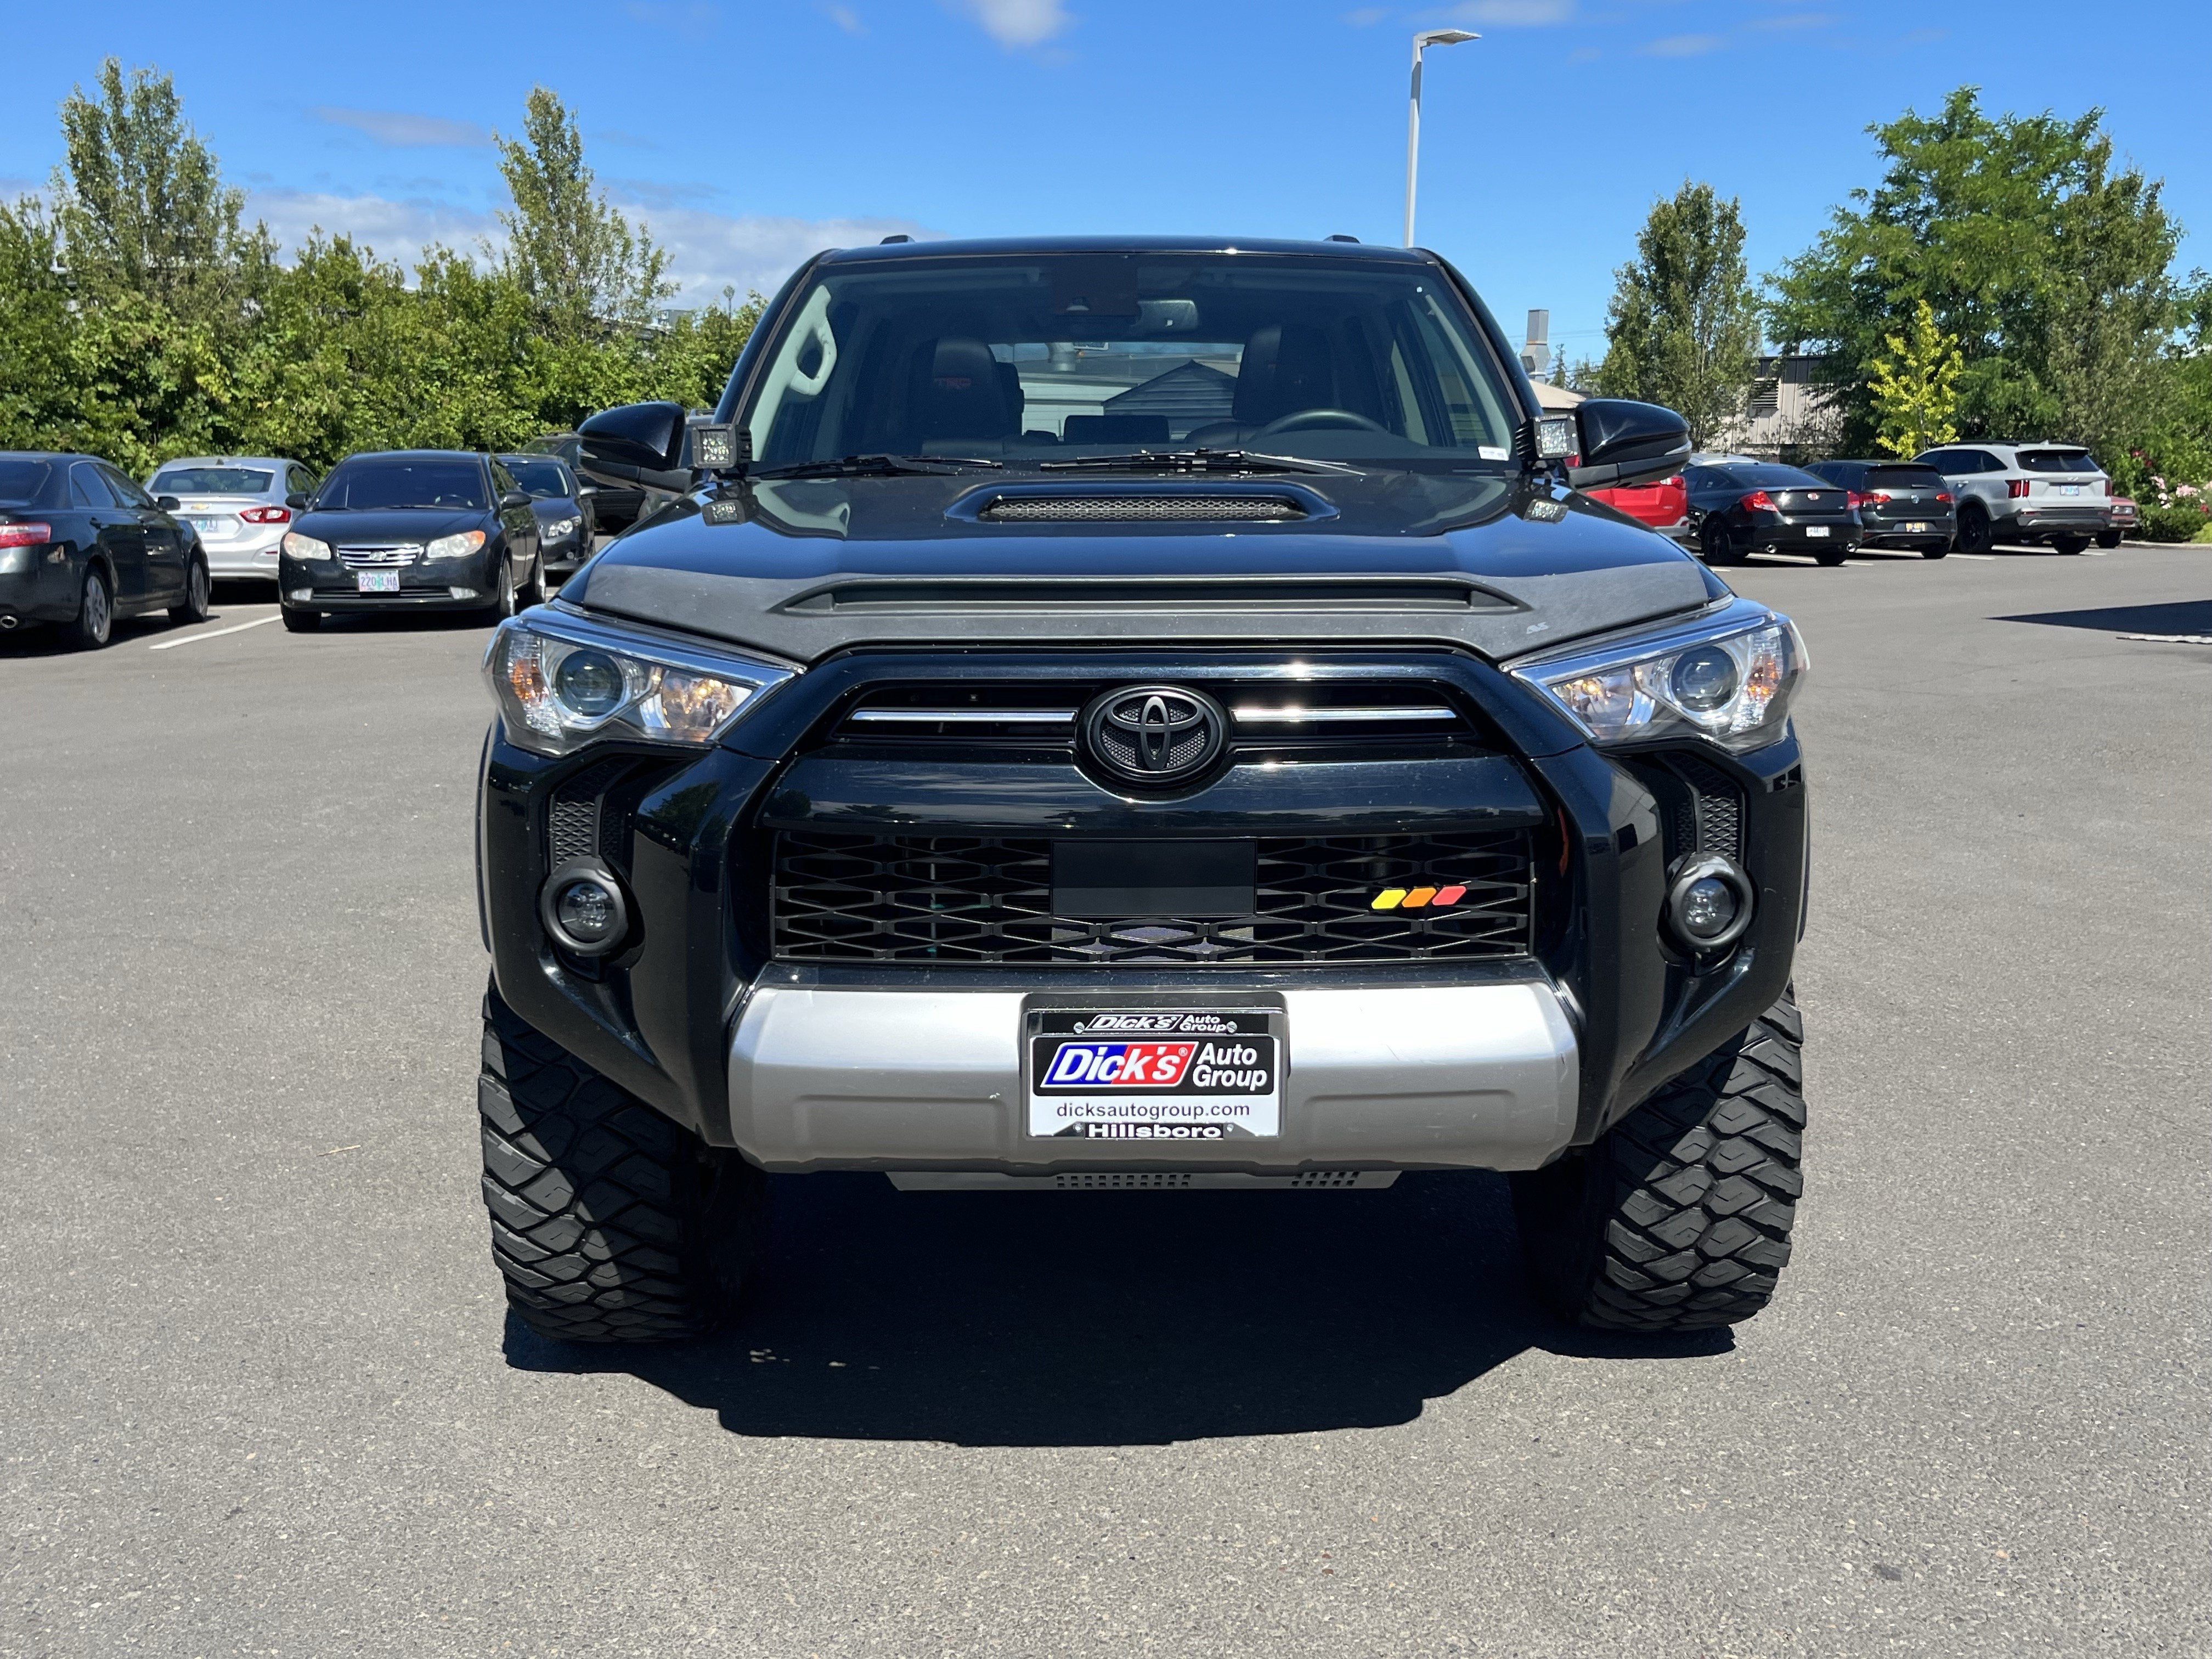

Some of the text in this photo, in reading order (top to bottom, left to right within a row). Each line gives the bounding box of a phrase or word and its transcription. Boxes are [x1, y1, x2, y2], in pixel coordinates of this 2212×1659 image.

[360, 576, 376, 586] 220
[1182, 1015, 1221, 1024] Auto
[1179, 1023, 1227, 1033] Group
[1196, 1043, 1257, 1065] Auto
[1192, 1065, 1267, 1091] Group
[1056, 1102, 1250, 1120] dicksautogroup.com
[1088, 1123, 1222, 1138] Hillsboro
